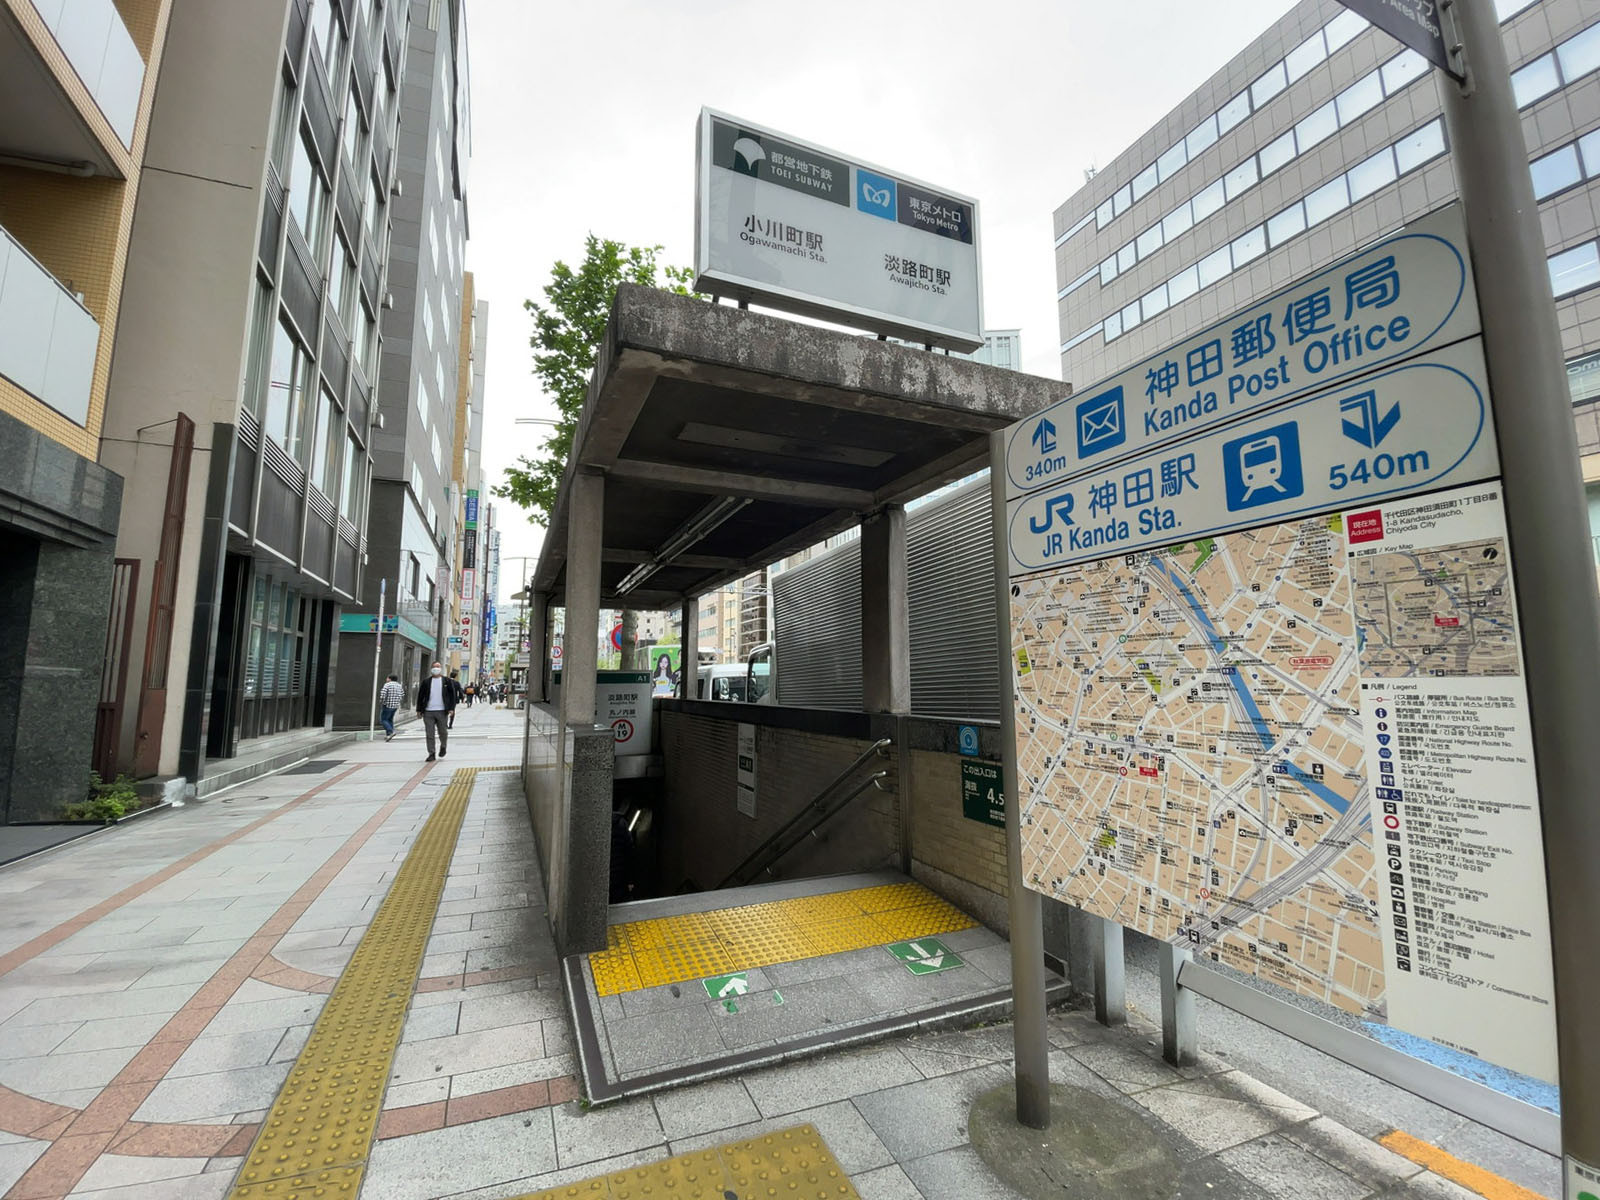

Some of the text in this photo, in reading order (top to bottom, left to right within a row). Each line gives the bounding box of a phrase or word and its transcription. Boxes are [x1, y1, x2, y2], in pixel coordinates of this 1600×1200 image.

[1416, 12, 1440, 39] Map
[770, 152, 833, 182] 都営地下鉄
[770, 166, 833, 193] TOEI SUBWAY
[908, 197, 961, 223] 東京メトロ
[912, 210, 959, 232] Tokyo Metro
[744, 214, 824, 253] 小川町駅
[739, 231, 828, 264] Ogawamachi Sta.
[884, 254, 951, 288] 淡路町駅
[889, 273, 948, 296] Awajicho Sta.
[1144, 254, 1400, 405] 神田郵便局
[1143, 315, 1411, 437] Kanda Post Office
[1025, 455, 1067, 482] 340m
[1329, 450, 1430, 490] 540m
[1029, 452, 1200, 535] JR 神田駅
[1352, 518, 1377, 529] 現在地
[1385, 509, 1464, 528] 1-8 Kandasudacho,
[1385, 521, 1436, 535] Chiyoda City
[1042, 505, 1182, 558] JR Kanda Sta.
[1350, 526, 1382, 537] Address
[617, 730, 628, 738] 19
[1435, 724, 1471, 732] Emergency
[1454, 738, 1481, 747] Highway
[1430, 751, 1467, 759] Metropolitan
[1468, 753, 1494, 762] Highway
[1495, 755, 1515, 763] Route
[1446, 766, 1472, 774] Elevator
[1430, 807, 1455, 817] Railway
[1456, 811, 1479, 820] Station
[1437, 824, 1463, 833] Subway
[1464, 828, 1488, 836] Station
[1460, 841, 1486, 851] Subway
[1487, 845, 1500, 853] Exit
[1409, 848, 1492, 868] タクシーのりば Taxi Stop
[1434, 866, 1458, 877] Parking
[1436, 882, 1462, 892] Bicycles
[1463, 887, 1489, 898] Parking
[1431, 895, 1456, 905] Hospital
[1440, 926, 1455, 934] Post
[1455, 930, 1475, 940] Office
[1460, 916, 1477, 925] Police
[1478, 920, 1497, 929] Station
[1501, 925, 1519, 935] Police
[1520, 929, 1532, 938] Box
[1436, 954, 1452, 963] Bank
[1476, 950, 1495, 960] Hotel
[1491, 984, 1531, 1000] Convenience
[1532, 995, 1549, 1005] Store
